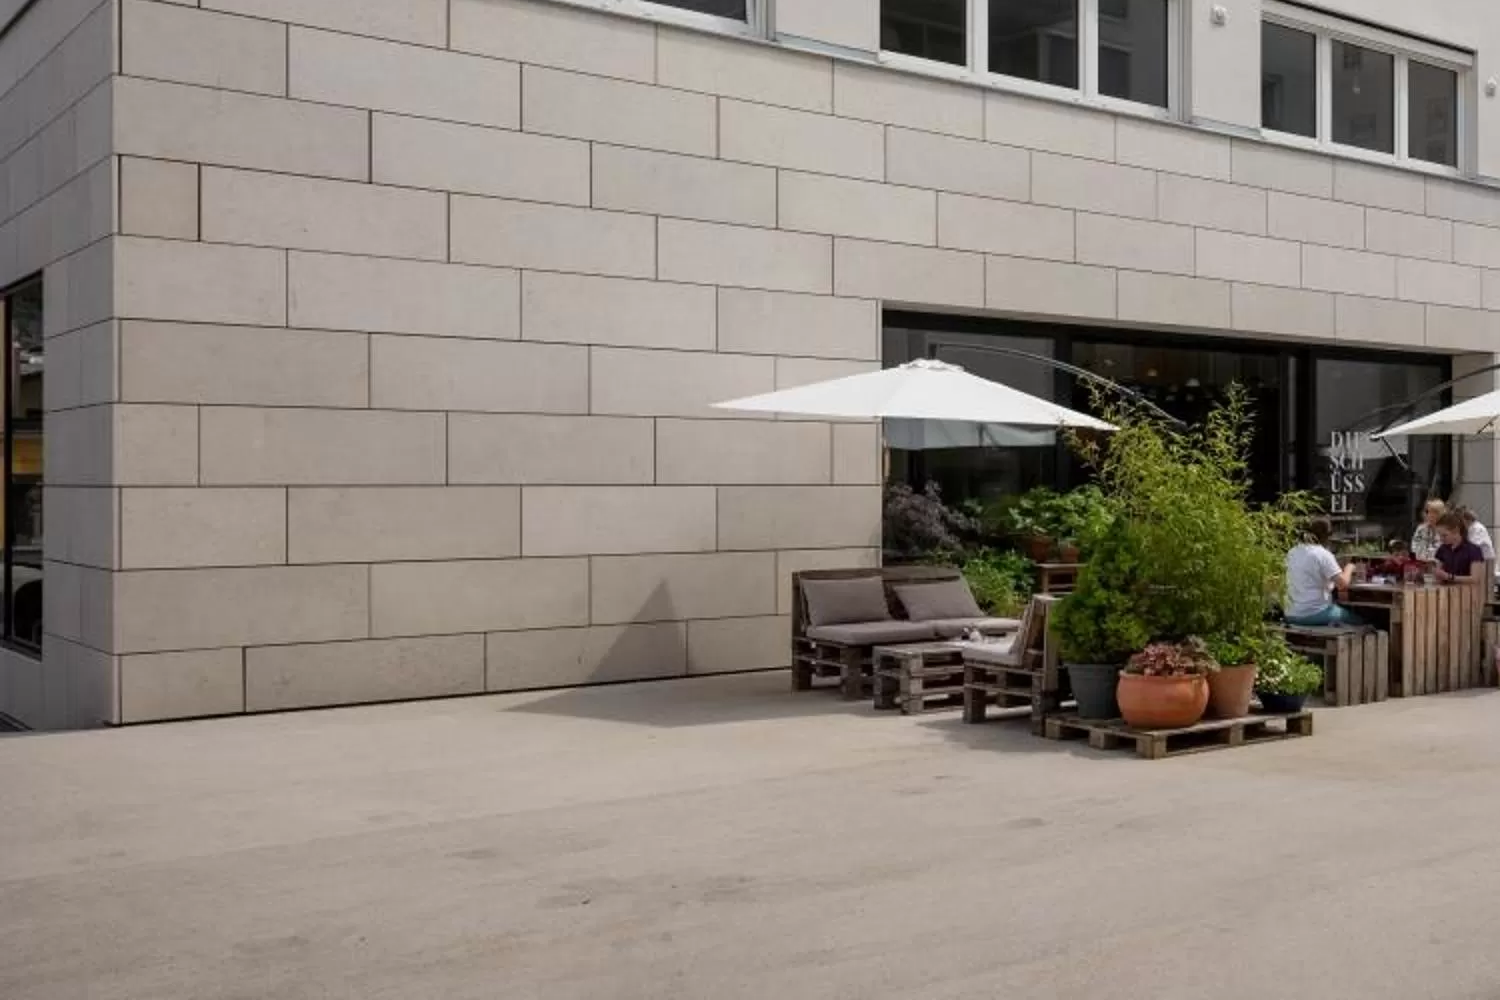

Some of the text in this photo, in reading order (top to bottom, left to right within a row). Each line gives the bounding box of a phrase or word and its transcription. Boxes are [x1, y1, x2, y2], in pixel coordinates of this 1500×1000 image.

[1329, 450, 1363, 470] SCH
[1330, 470, 1365, 493] ÜSS
[1331, 494, 1352, 513] EL
